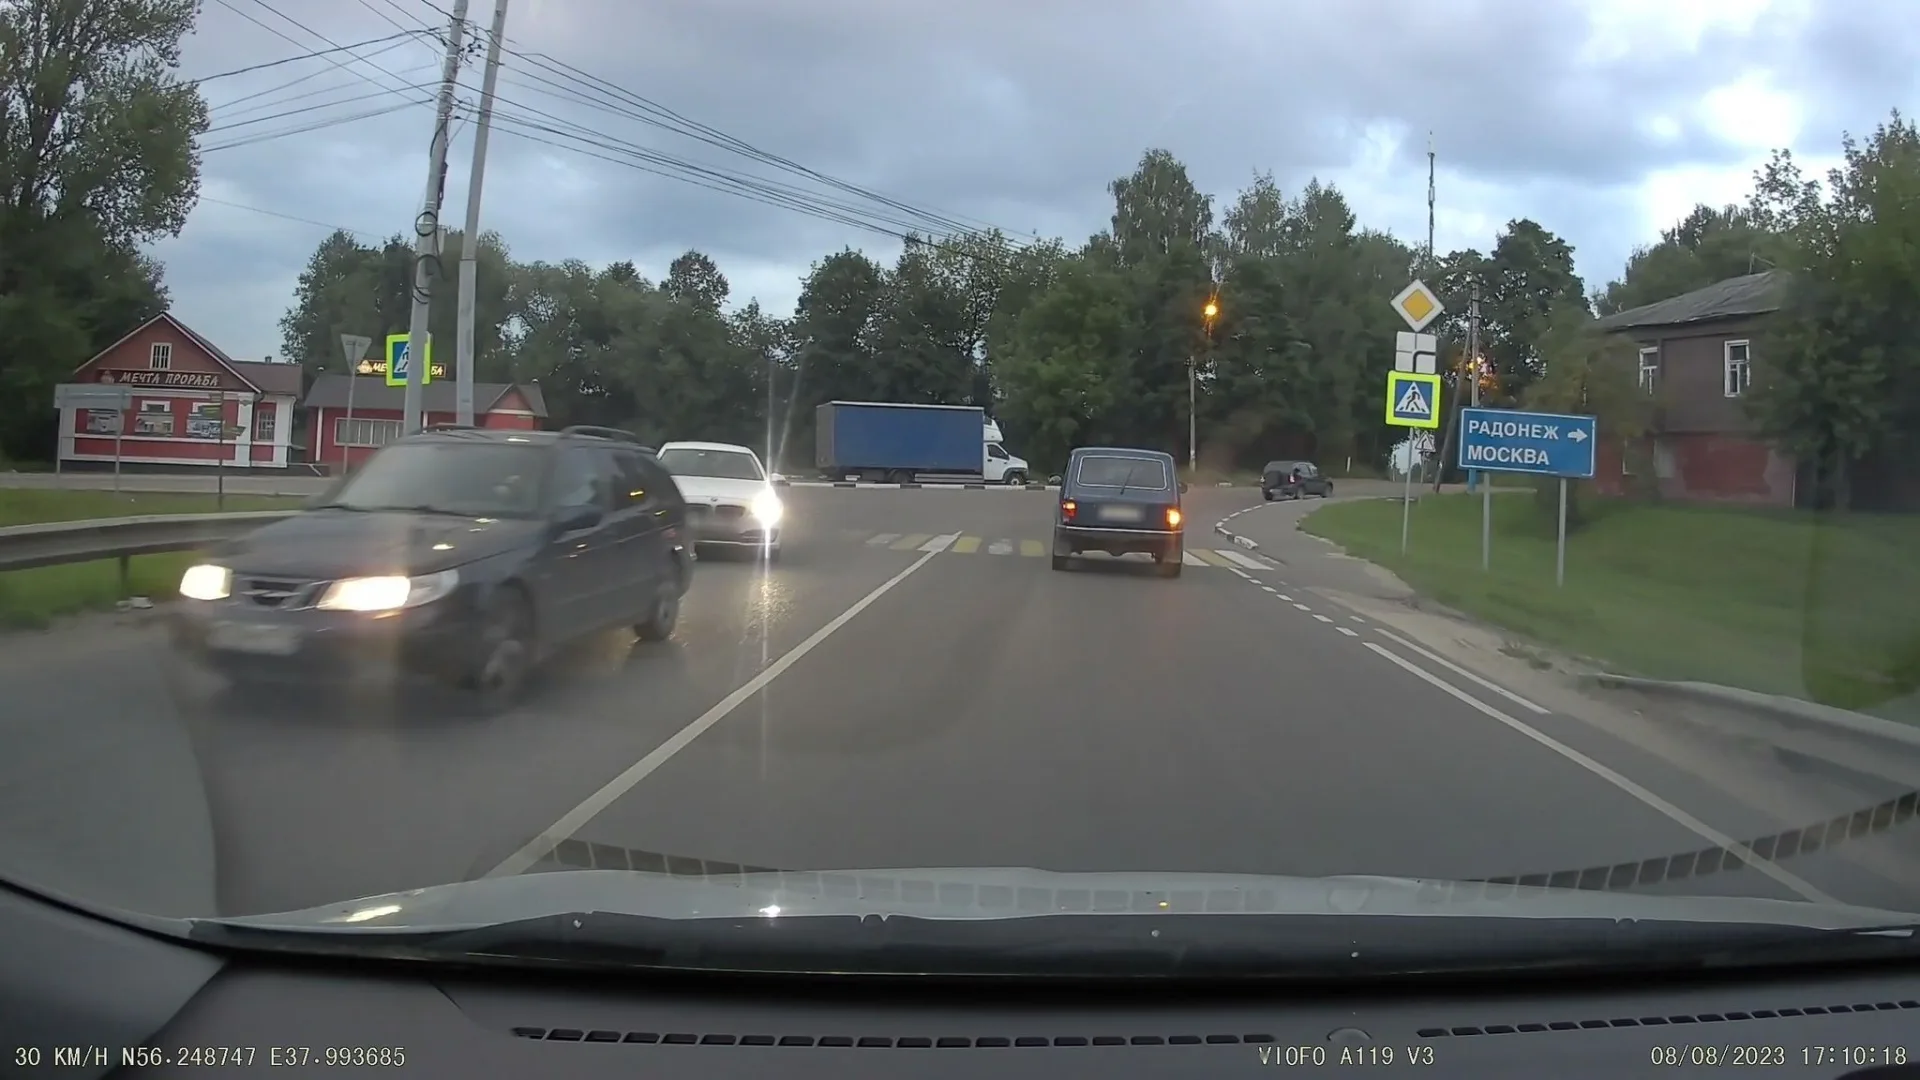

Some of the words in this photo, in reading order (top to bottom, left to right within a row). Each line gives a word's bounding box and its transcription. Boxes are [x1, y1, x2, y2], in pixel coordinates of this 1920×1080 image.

[119, 372, 160, 384] МЕЧТА
[165, 373, 219, 387] ПРОРАБА
[1468, 420, 1560, 440] РАДОНЕЖ
[1467, 445, 1550, 466] МОСКВА
